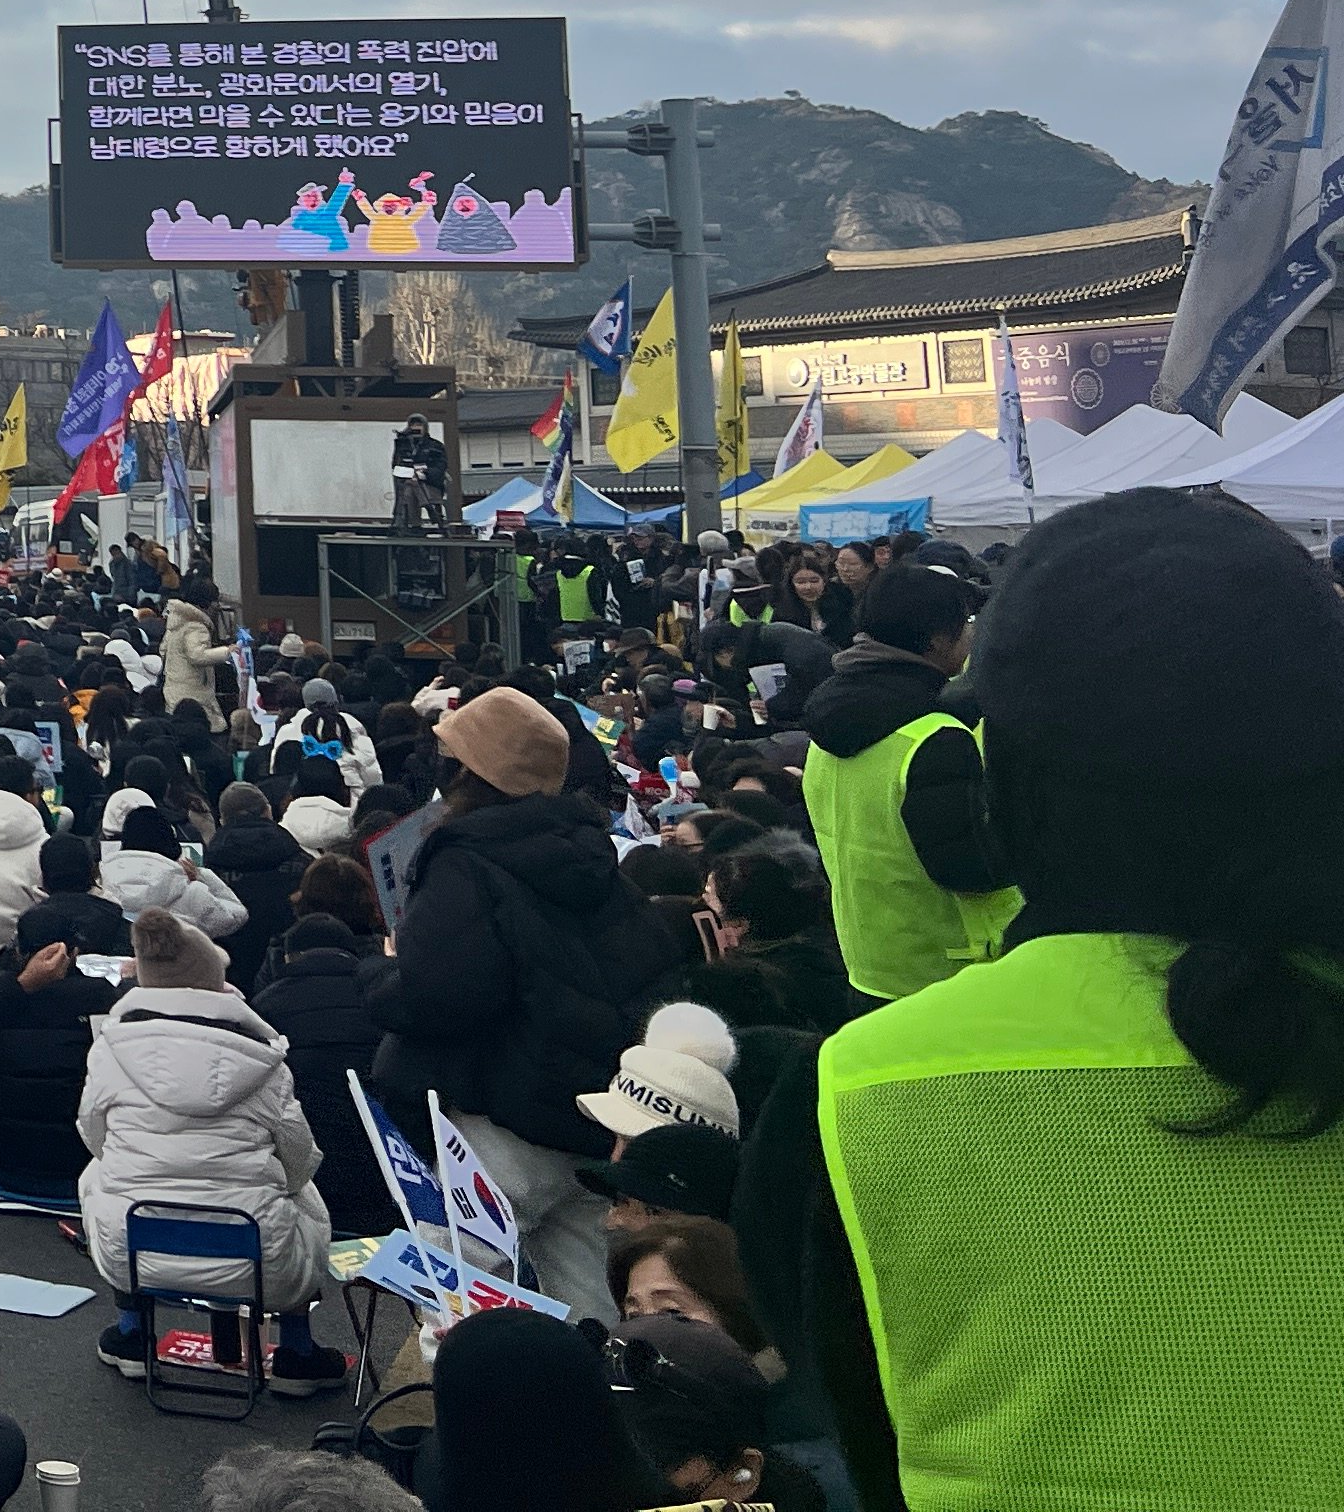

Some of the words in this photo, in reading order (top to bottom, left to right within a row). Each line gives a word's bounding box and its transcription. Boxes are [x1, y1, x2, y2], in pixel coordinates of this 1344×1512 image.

[178, 41, 234, 66] 통해
[240, 41, 267, 66] 본
[272, 40, 350, 66] 경찰의
[356, 40, 412, 64] 폭력
[416, 38, 498, 64] 진압에
[88, 73, 146, 100] 대한
[151, 72, 214, 100] 분노,
[218, 71, 384, 97] 광화문에서의
[388, 71, 449, 97] 열기,
[88, 104, 194, 130] 함께라면
[198, 103, 252, 130] 막을
[258, 103, 286, 130] 수
[291, 103, 373, 128] 있다는
[378, 102, 459, 127] 용기와
[464, 102, 544, 126] 믿음이
[89, 135, 220, 161] 남태령으로
[225, 135, 309, 159] 향하게
[314, 131, 410, 159] 했어요”
